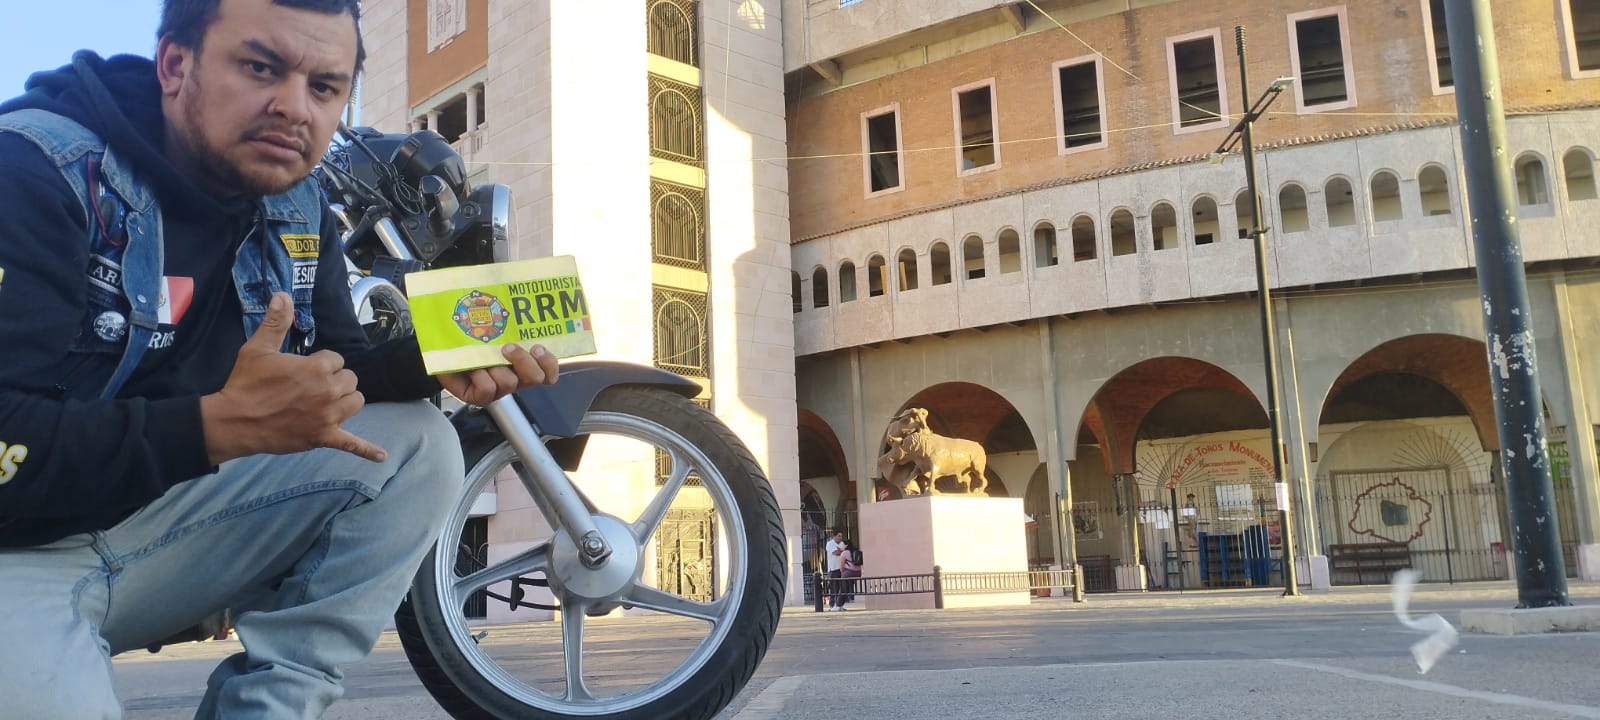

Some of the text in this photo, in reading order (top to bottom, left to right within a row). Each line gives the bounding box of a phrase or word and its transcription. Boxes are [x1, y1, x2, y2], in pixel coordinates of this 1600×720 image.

[509, 276, 581, 296] MOTOTURISTA
[511, 290, 588, 326] RRM
[519, 323, 563, 341] MEXICO
